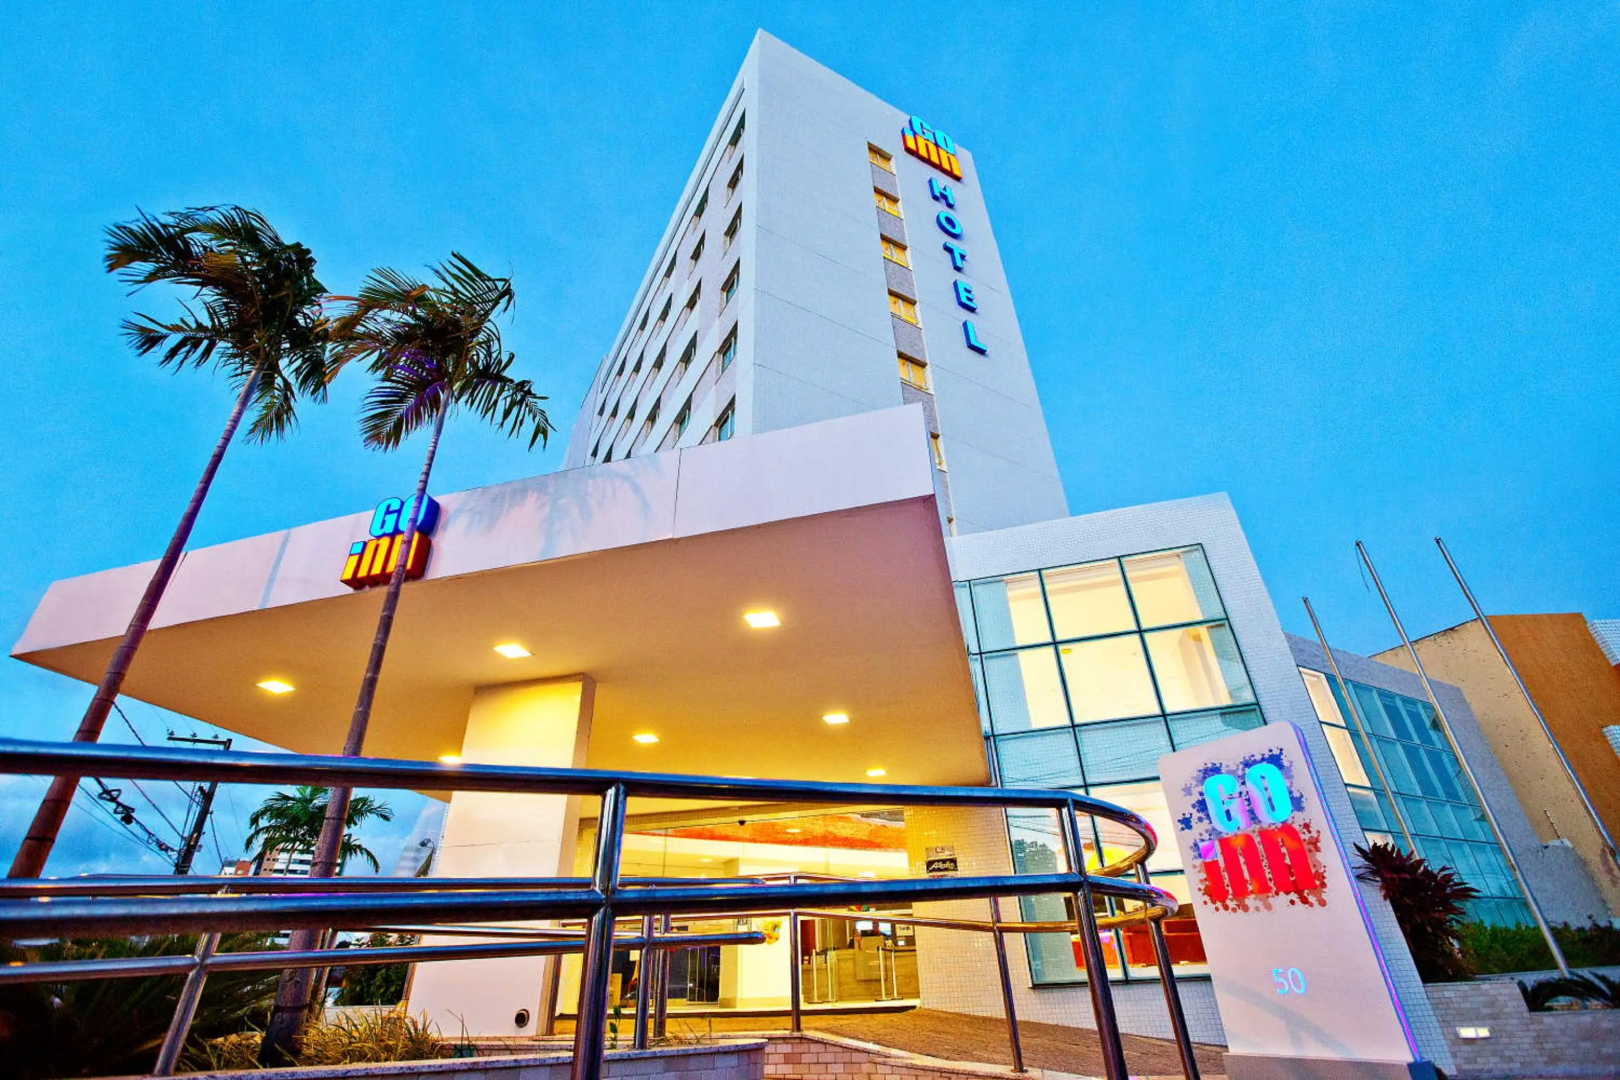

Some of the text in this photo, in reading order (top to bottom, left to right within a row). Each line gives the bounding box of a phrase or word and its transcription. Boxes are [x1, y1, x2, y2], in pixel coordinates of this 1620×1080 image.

[909, 115, 957, 155] GO
[928, 177, 988, 355] HOTEL
[369, 493, 436, 537] GO
[1203, 762, 1293, 833] GO
[1271, 967, 1307, 995] 50
